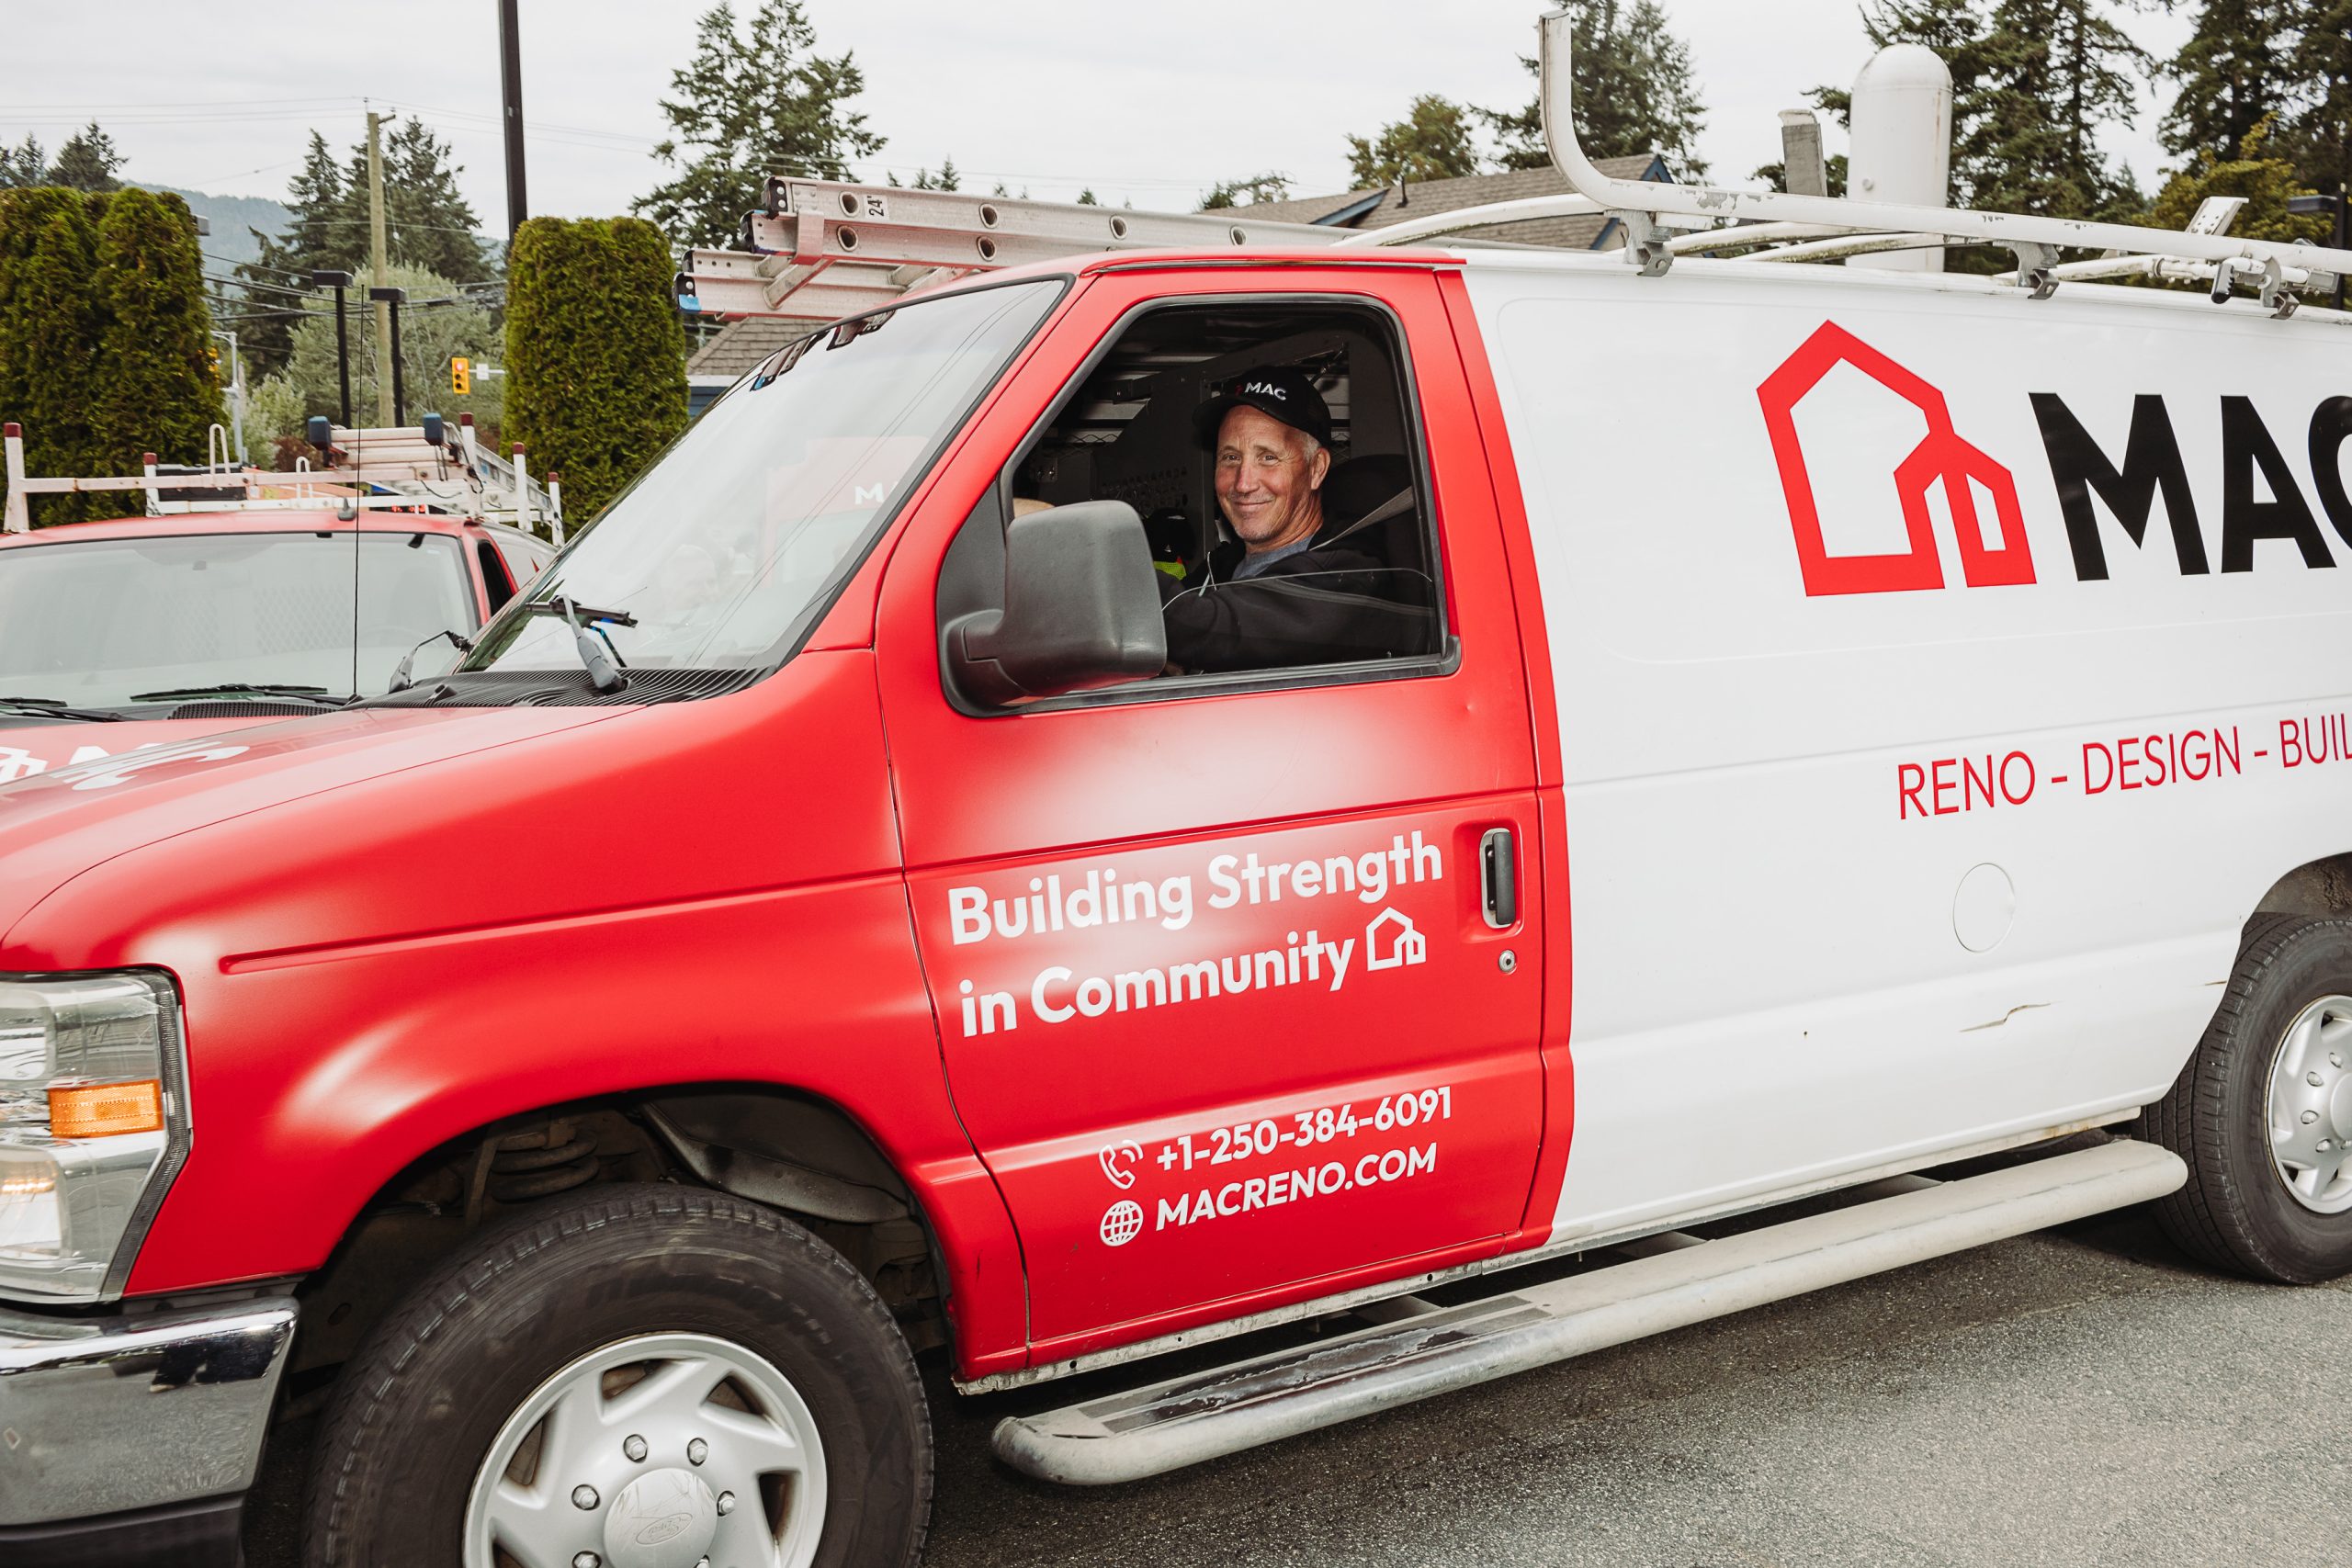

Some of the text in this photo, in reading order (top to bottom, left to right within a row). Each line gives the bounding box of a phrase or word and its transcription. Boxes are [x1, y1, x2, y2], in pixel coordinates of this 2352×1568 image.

[1244, 381, 1287, 401] MAC
[1897, 749, 2036, 821] RENO
[2082, 725, 2242, 795] DESIGN
[948, 829, 1443, 945] Building Strength
[958, 931, 1356, 1038] in Community
[1157, 1085, 1452, 1172] +1-250-384-6091
[1156, 1142, 1438, 1231] MACRENO.COM
